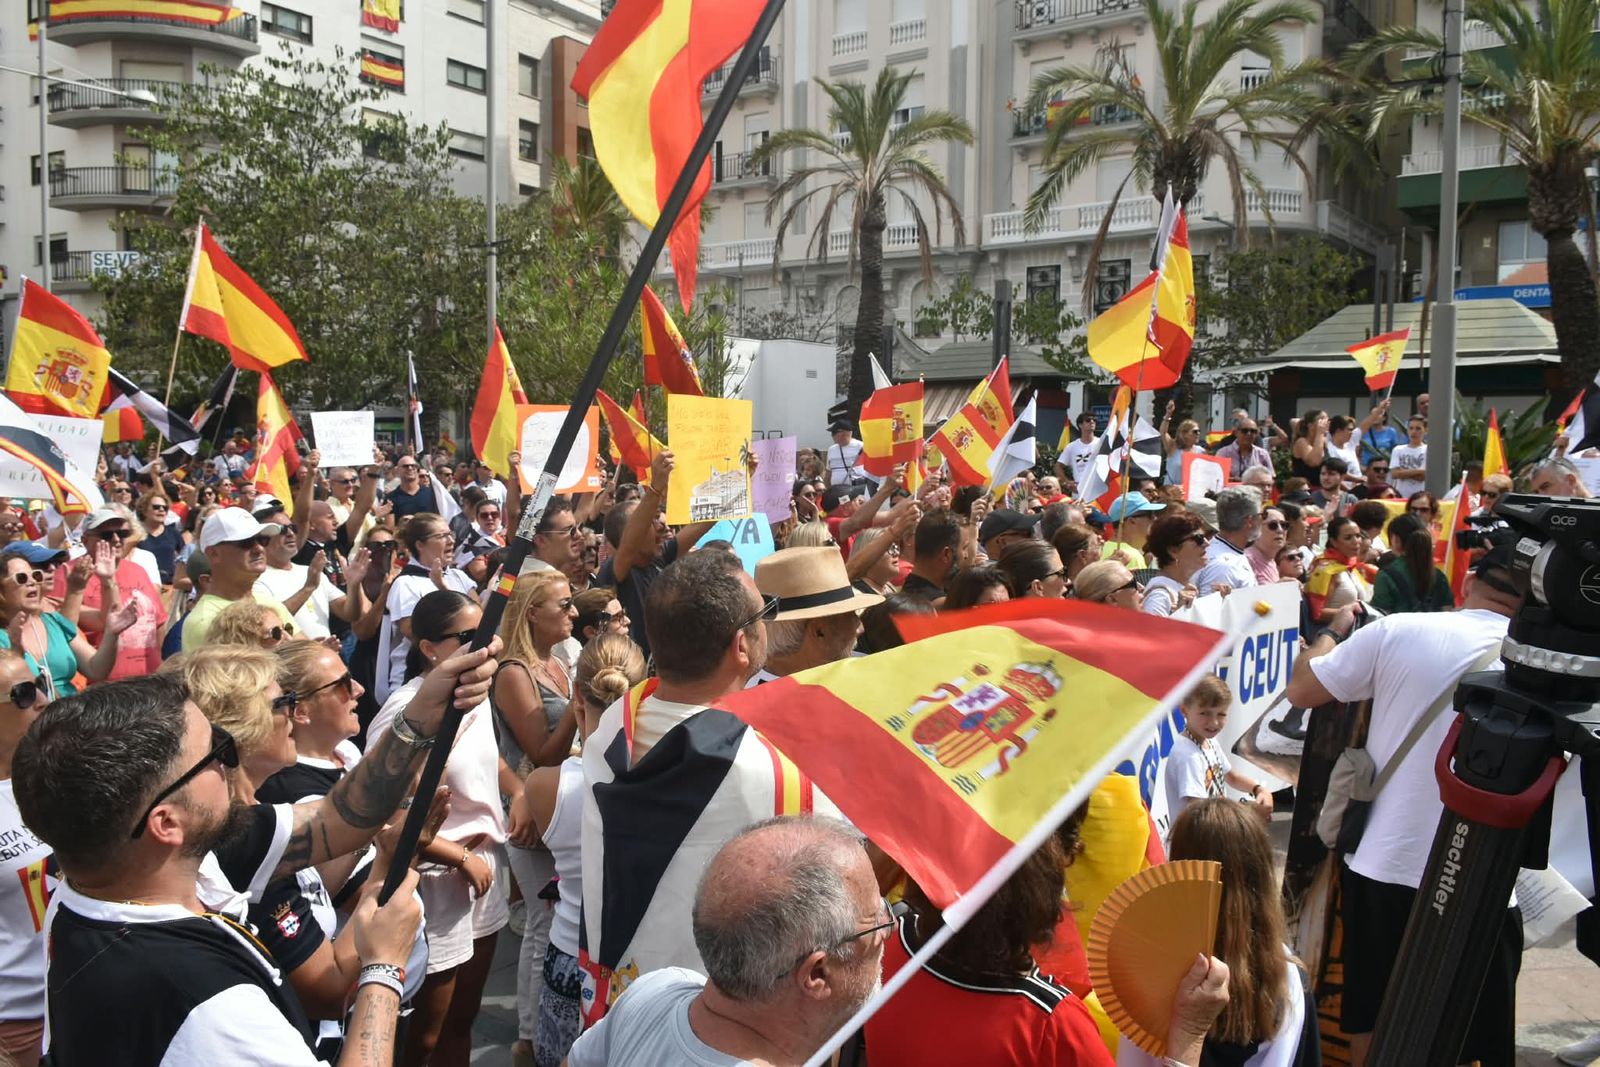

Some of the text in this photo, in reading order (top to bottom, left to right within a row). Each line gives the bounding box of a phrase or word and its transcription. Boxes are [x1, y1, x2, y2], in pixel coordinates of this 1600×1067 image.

[94, 252, 113, 266] SE
[1551, 515, 1577, 526] ace
[728, 518, 761, 545] YA
[0, 830, 24, 848] UTA
[1432, 822, 1469, 916] sachtler
